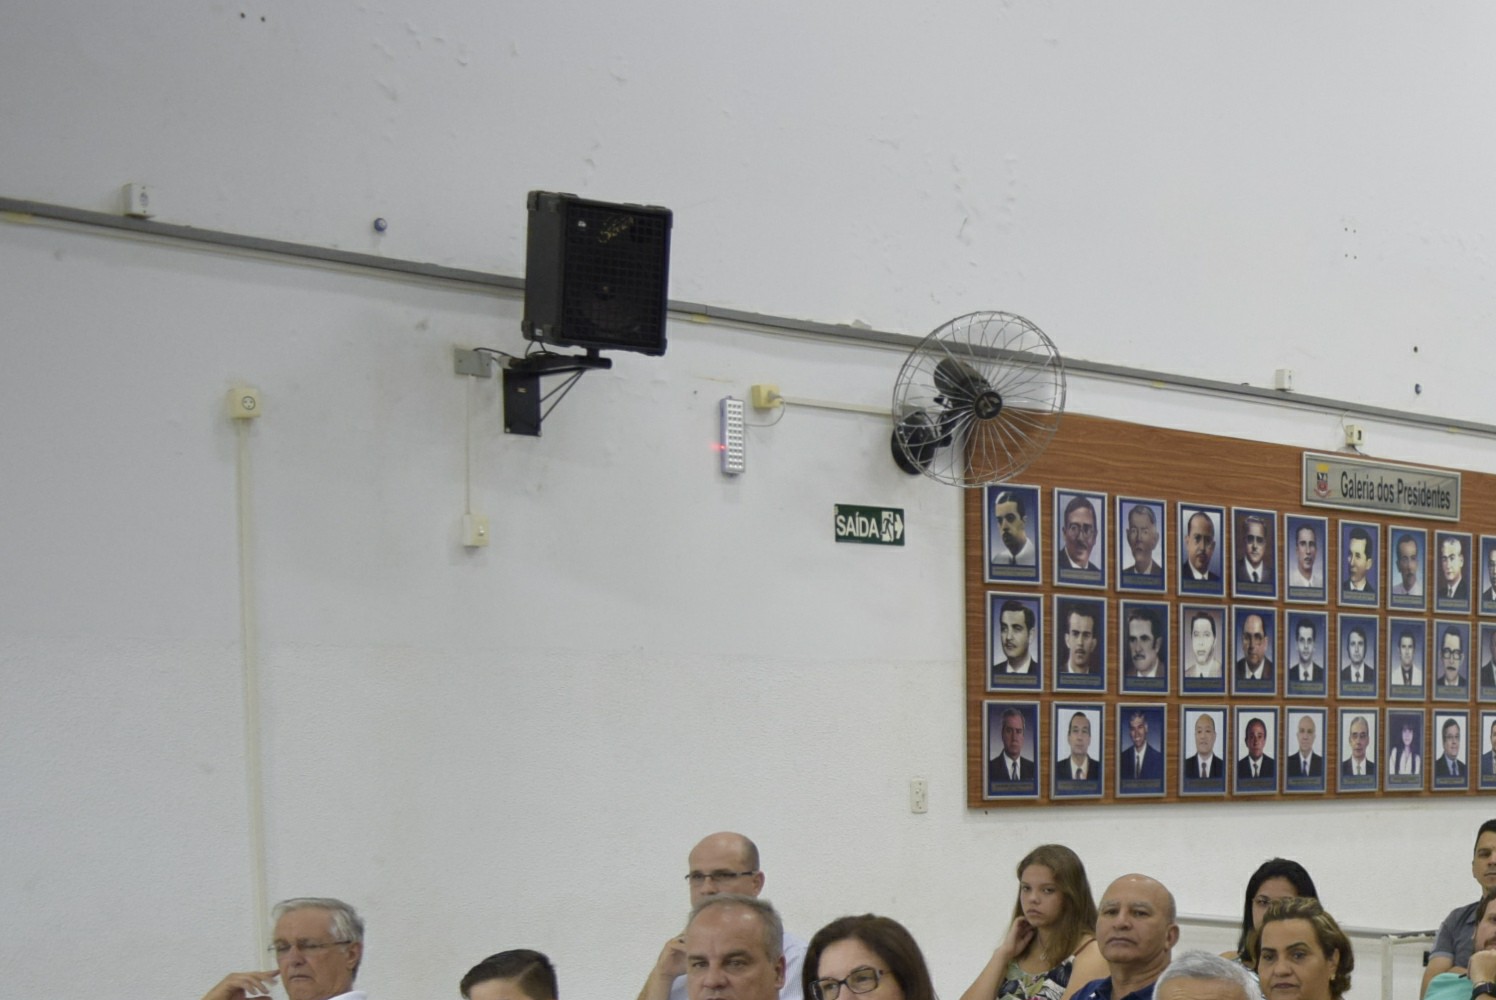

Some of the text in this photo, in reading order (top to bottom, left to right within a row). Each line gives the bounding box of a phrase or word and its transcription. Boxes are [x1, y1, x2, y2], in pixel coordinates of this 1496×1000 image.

[1340, 471, 1451, 510] Galeria dos Presidentes
[836, 511, 880, 538] SAÍDA
